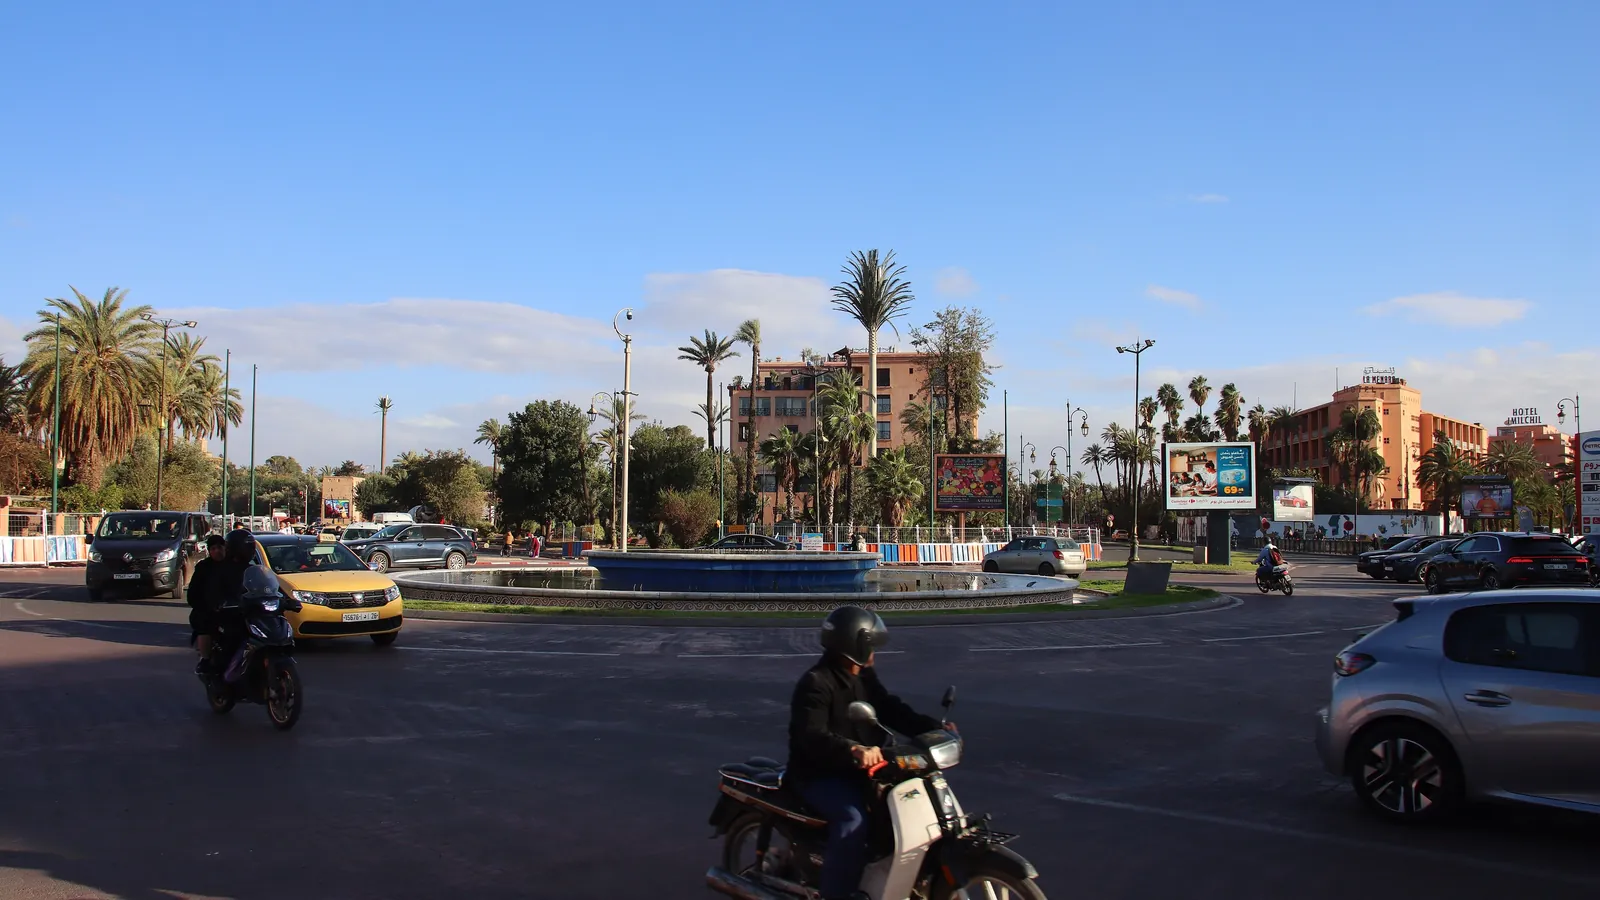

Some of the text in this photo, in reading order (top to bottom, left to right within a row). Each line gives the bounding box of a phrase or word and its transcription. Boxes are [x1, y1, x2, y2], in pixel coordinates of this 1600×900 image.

[1363, 375, 1396, 384] LA MENARA
[1512, 407, 1538, 416] HOTEL
[1507, 416, 1542, 424] IMILCHIL
